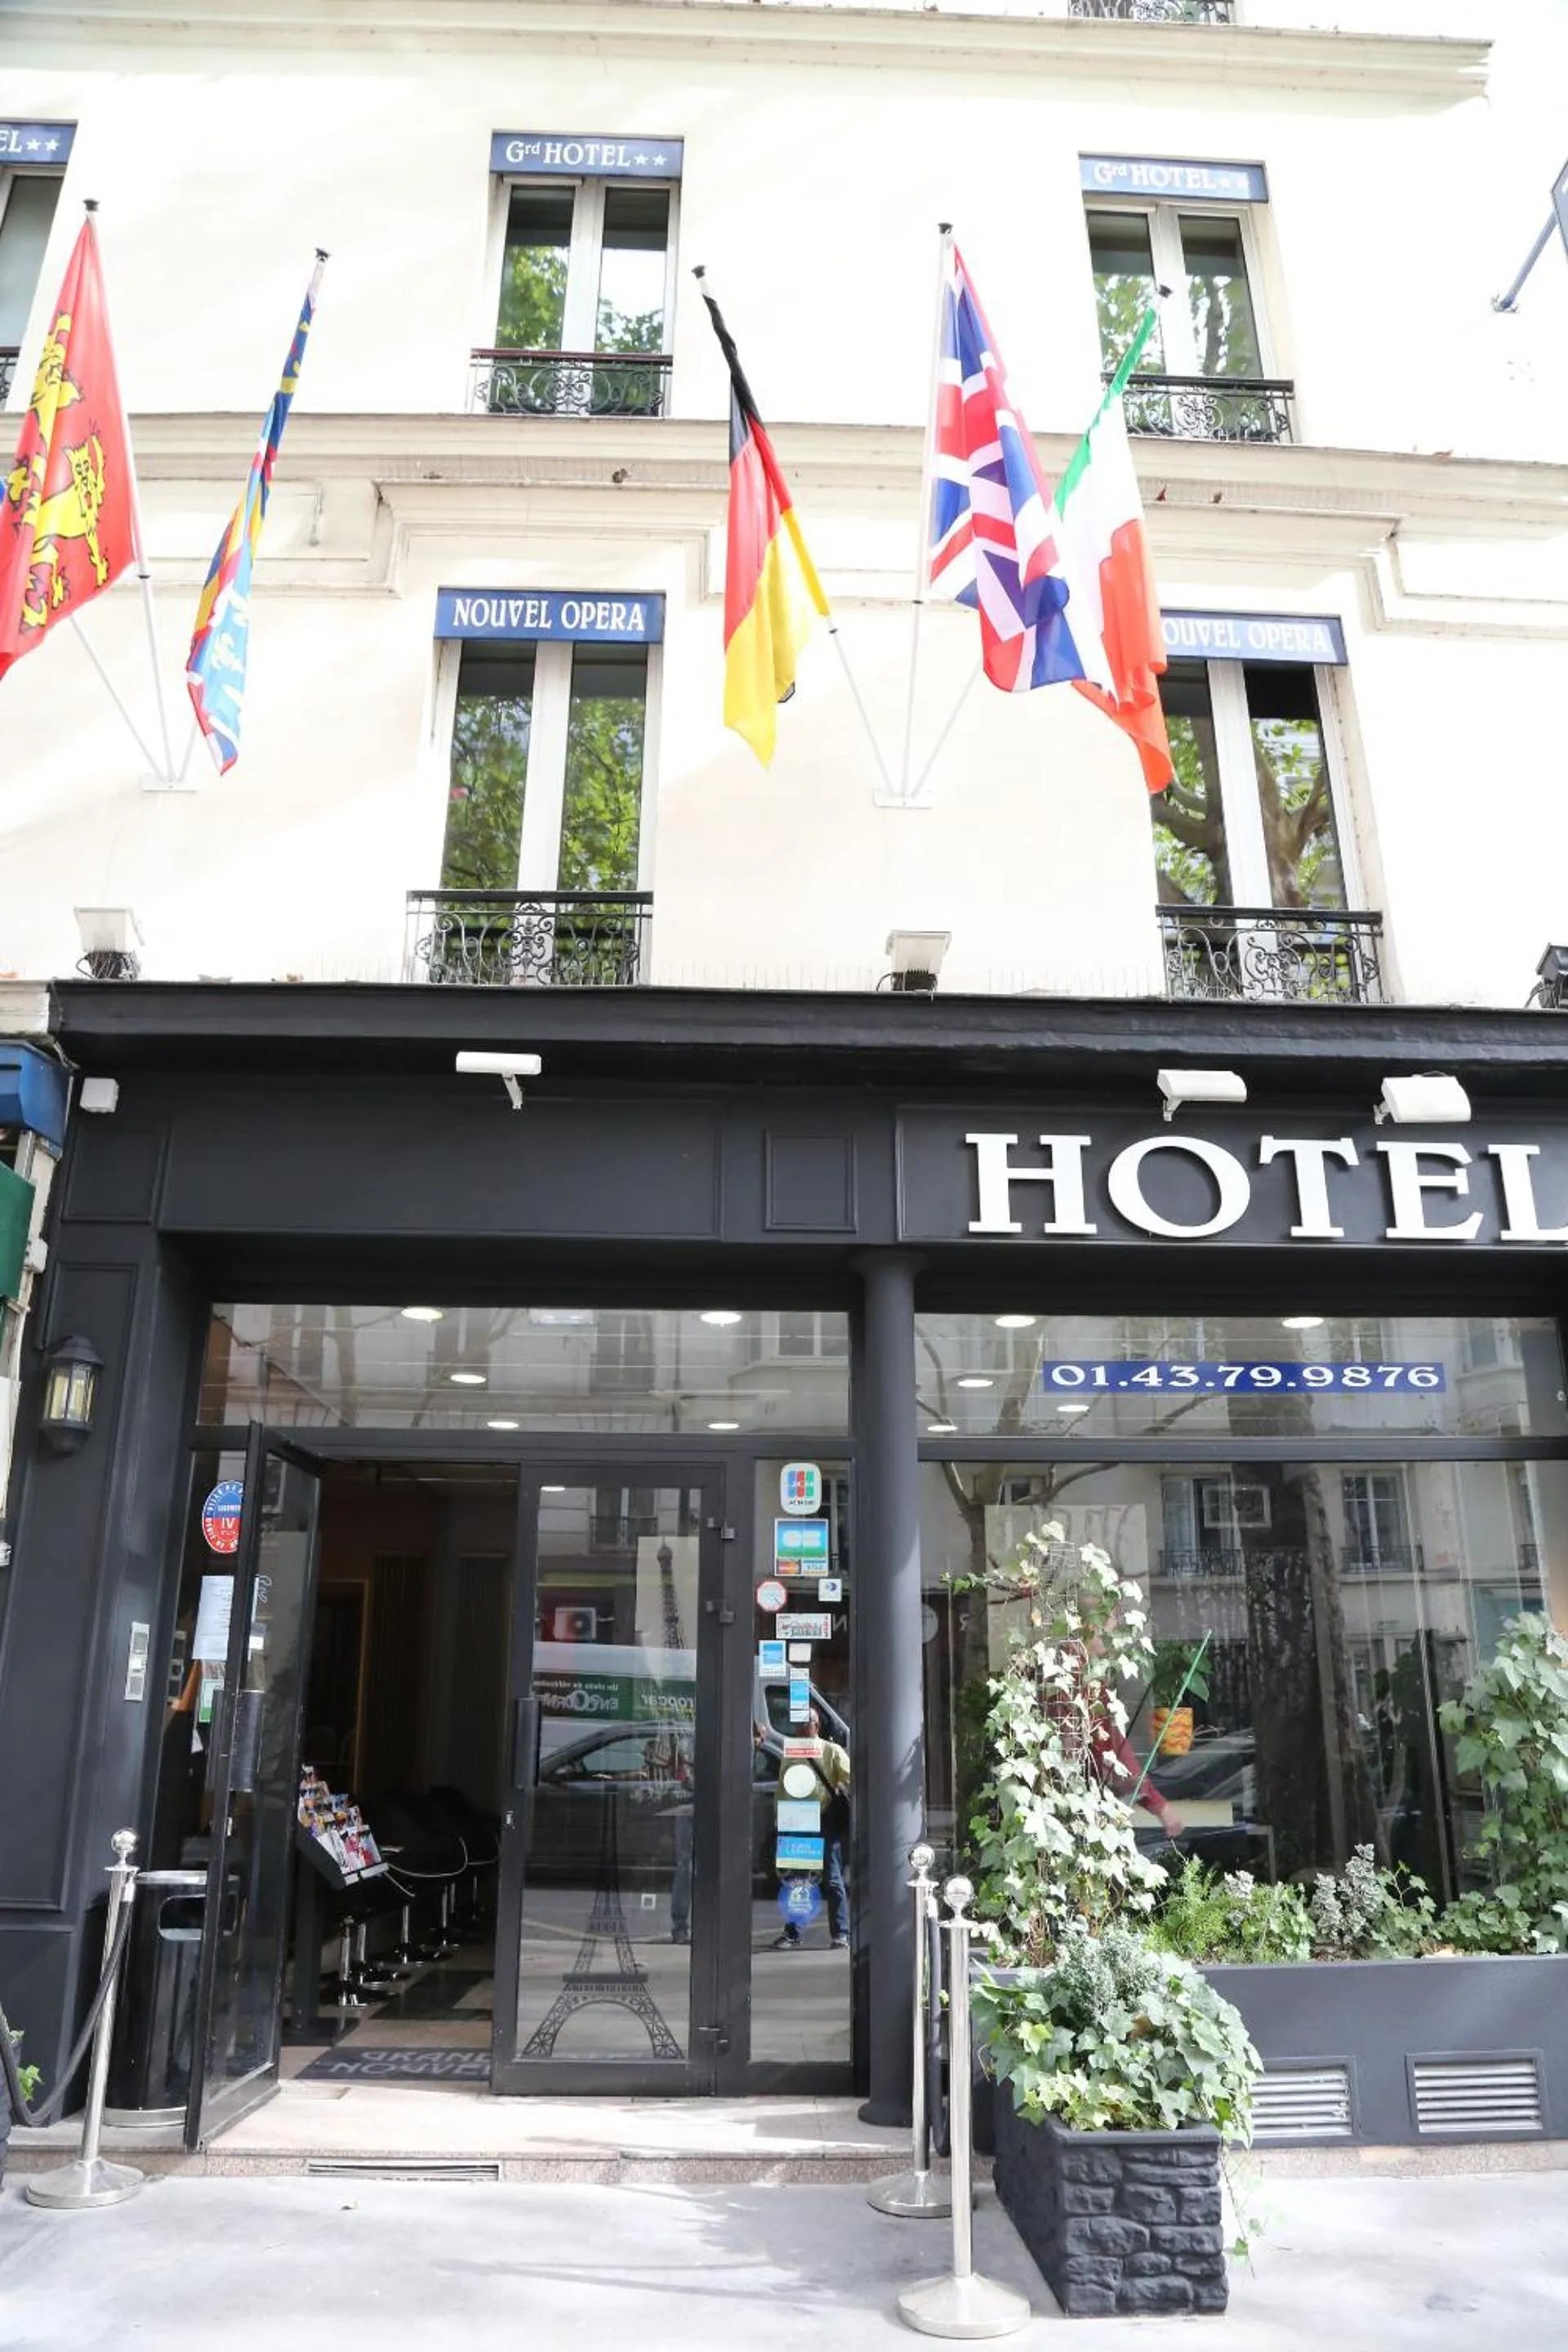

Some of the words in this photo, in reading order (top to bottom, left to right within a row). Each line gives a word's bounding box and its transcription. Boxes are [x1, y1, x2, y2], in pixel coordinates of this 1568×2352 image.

[506, 140, 541, 163] Grd
[542, 142, 630, 167] HOTEL
[1129, 164, 1216, 189] HOTEL
[452, 598, 552, 629] NOUVEL
[560, 601, 645, 631] OPERA
[1160, 617, 1241, 648] OUVEL
[1247, 622, 1330, 653] OPERA
[964, 1133, 1568, 1239] HOTEL
[1050, 1365, 1440, 1388] 01.43.79.9876
[221, 1517, 236, 1530] IV
